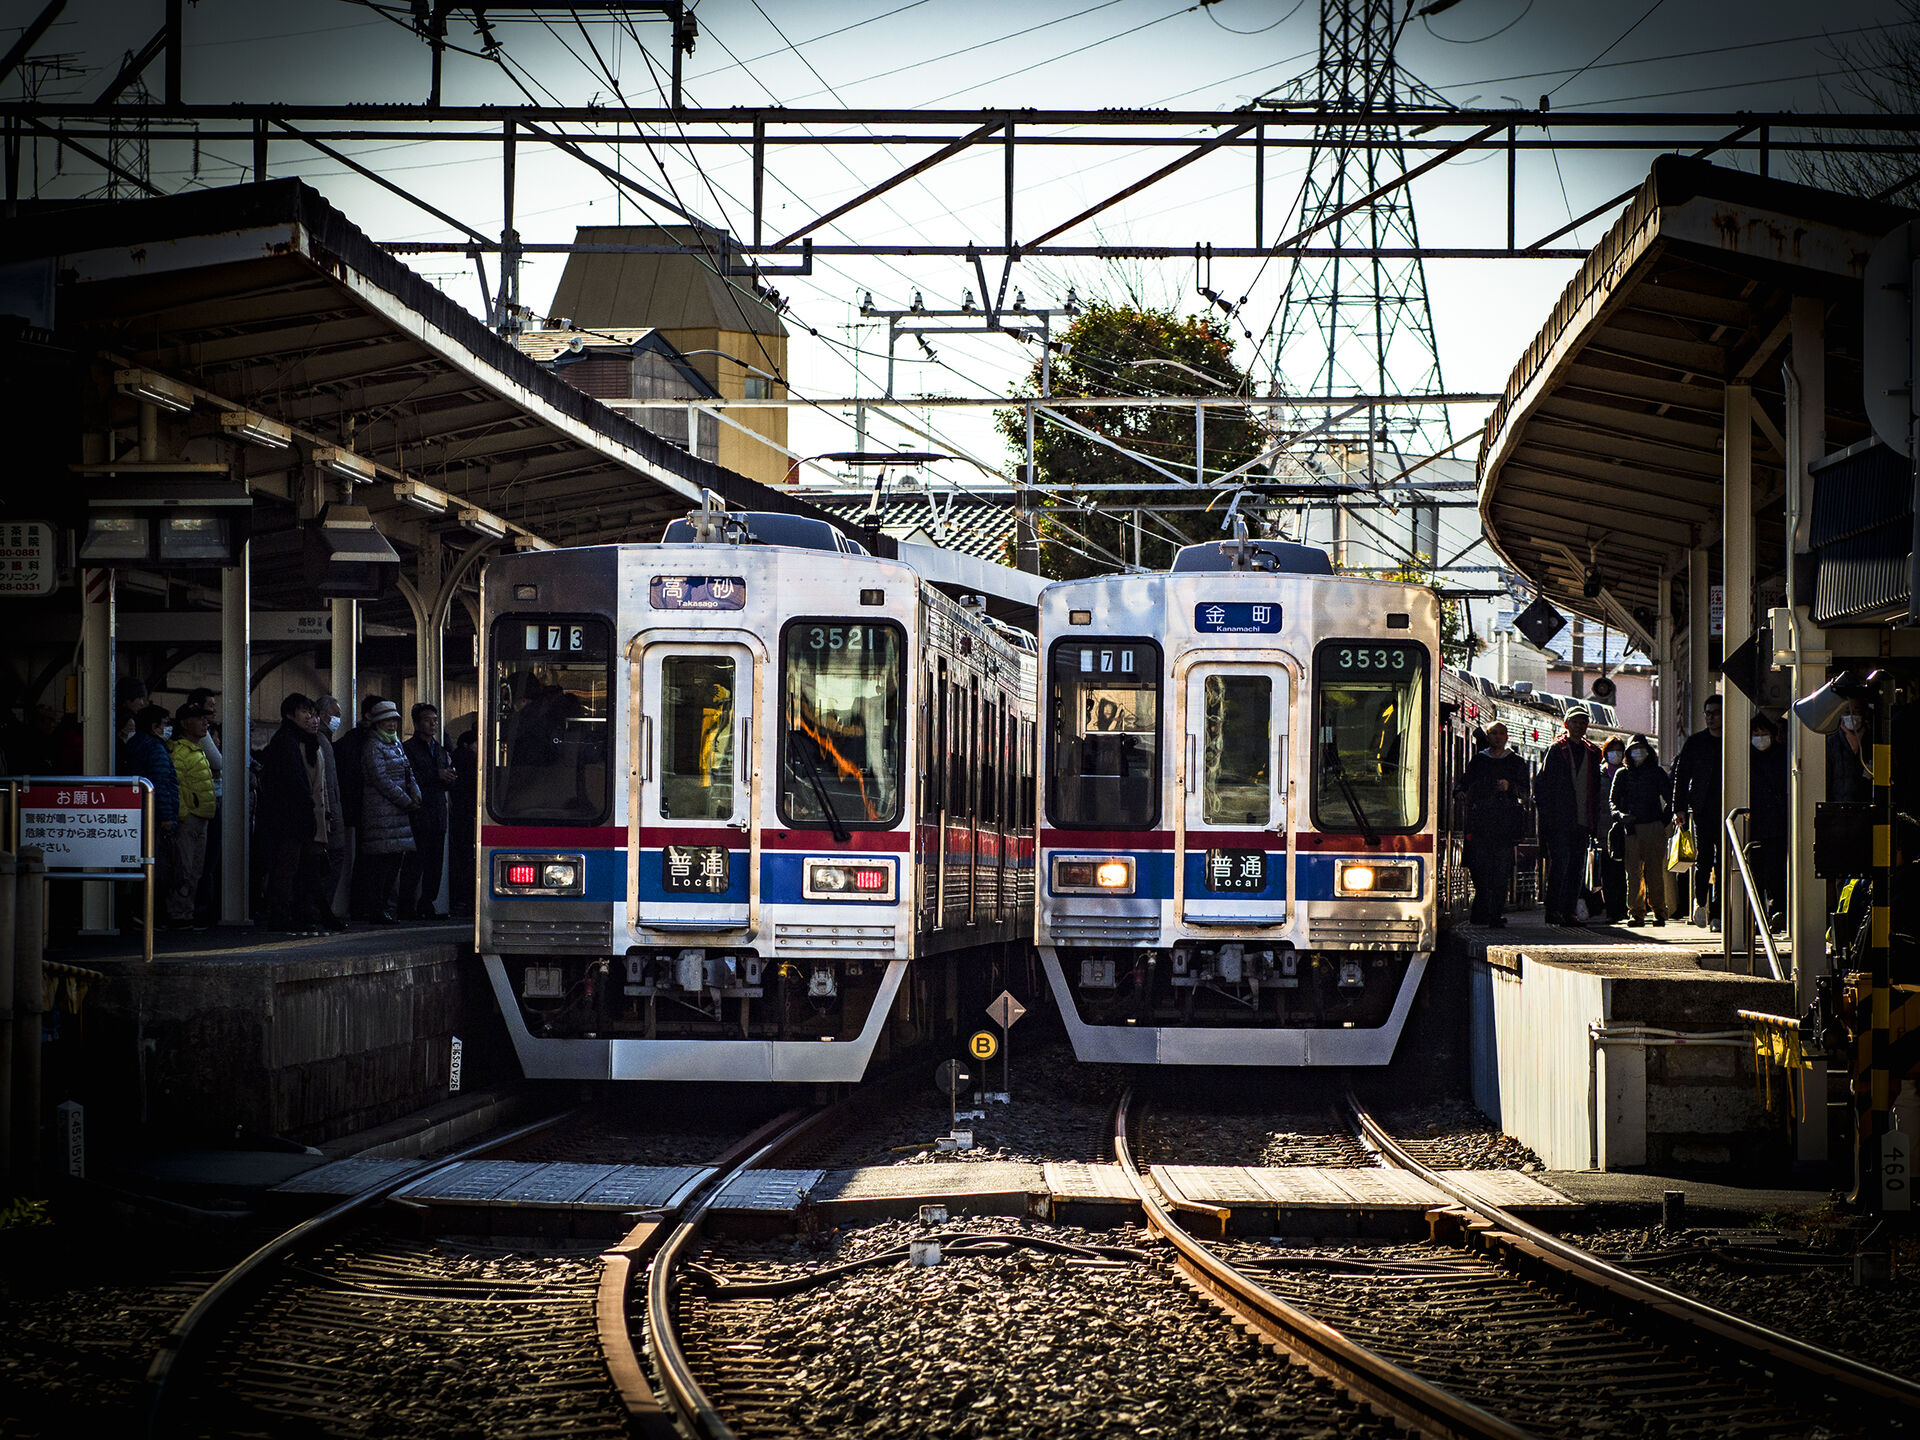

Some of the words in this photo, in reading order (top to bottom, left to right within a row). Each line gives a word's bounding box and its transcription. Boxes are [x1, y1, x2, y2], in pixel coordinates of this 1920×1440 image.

[662, 577, 734, 599] 高砂
[677, 599, 718, 608] Takasago
[1205, 605, 1272, 625] 金町
[809, 627, 874, 650] 3521
[1339, 649, 1405, 669] 3533
[56, 790, 106, 806] お願い
[25, 813, 128, 824] 警報が鳴っている間は
[25, 828, 138, 838] 危険ですから渡らないで
[668, 852, 724, 877] 普通
[1211, 855, 1262, 878] 普通
[672, 877, 720, 888] Local
[1215, 878, 1258, 887] Local
[976, 1037, 991, 1053] B
[1883, 1147, 1905, 1191] 460
